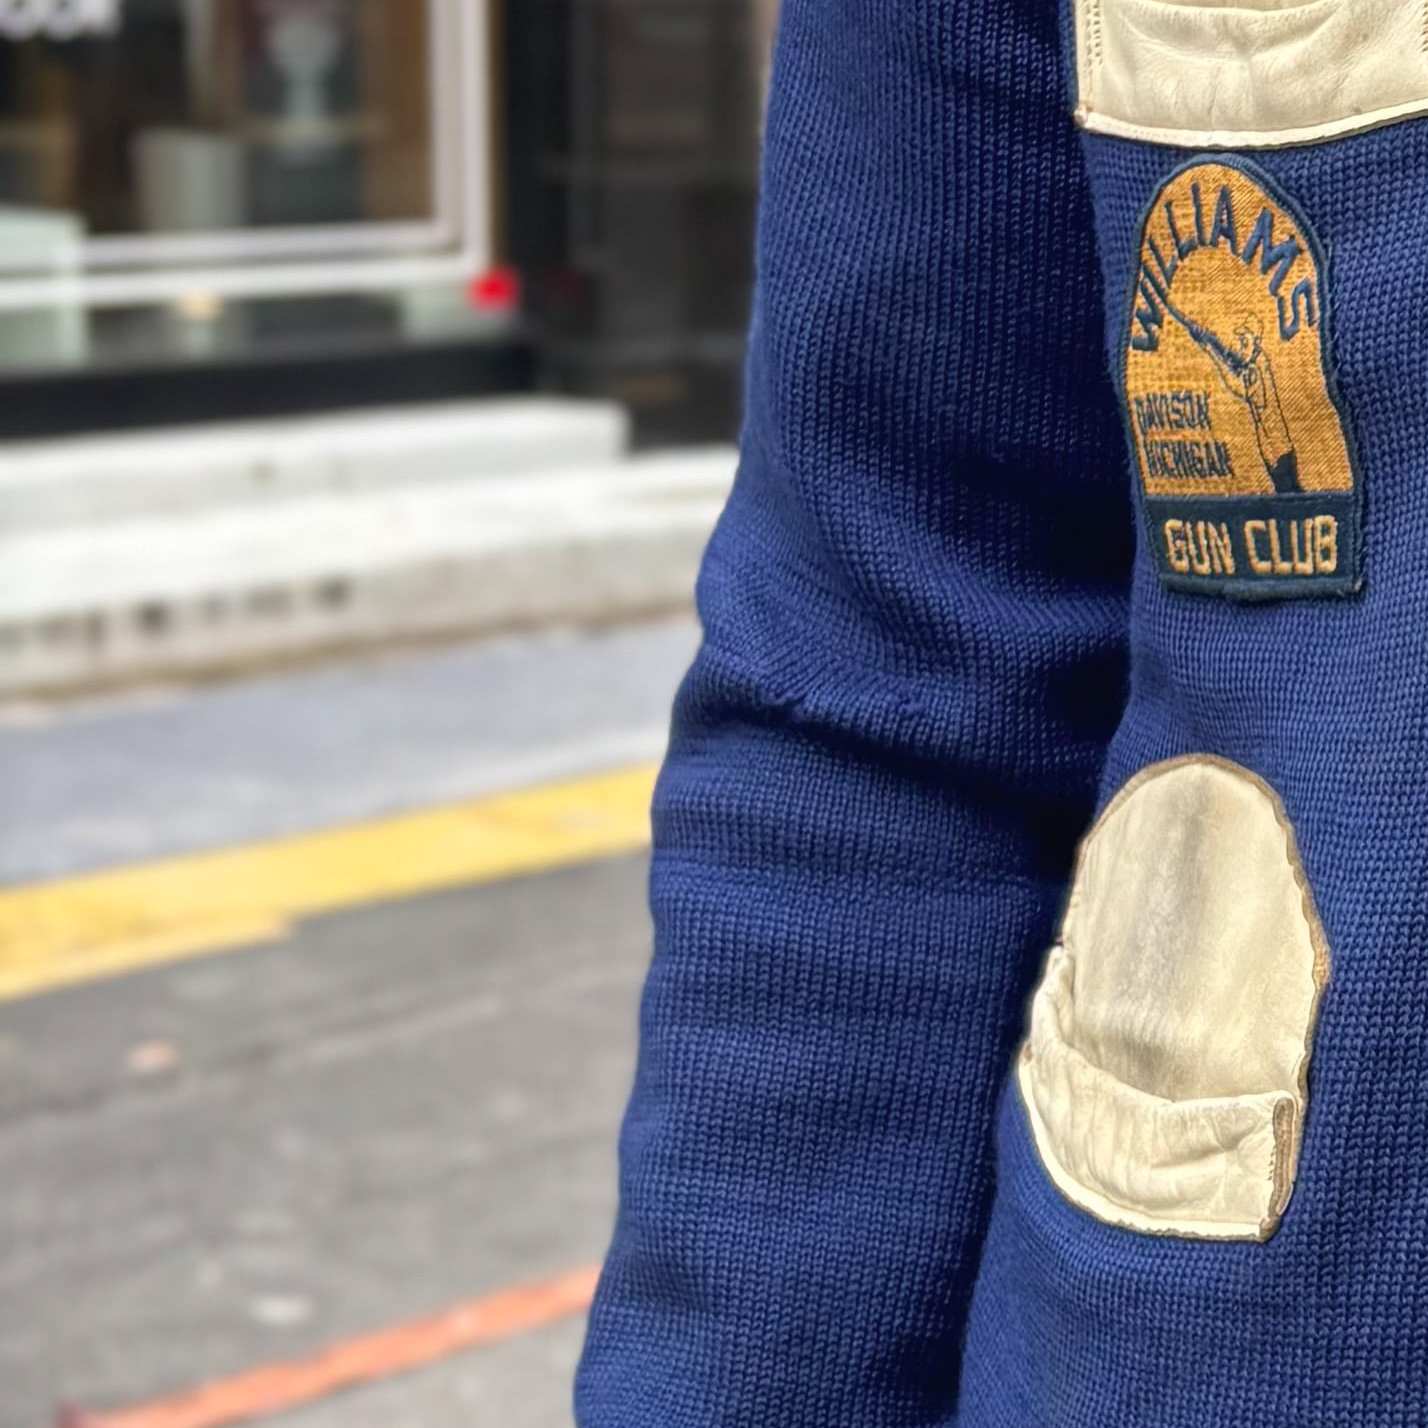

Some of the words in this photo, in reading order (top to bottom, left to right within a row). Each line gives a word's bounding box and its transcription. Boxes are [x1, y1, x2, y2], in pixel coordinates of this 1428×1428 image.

[1131, 182, 1318, 352] WILLIAMS
[1134, 390, 1212, 436] DAVISON
[1145, 440, 1234, 479] MICHIGAN
[1163, 518, 1235, 574] GUN
[1243, 514, 1338, 574] CLUB
